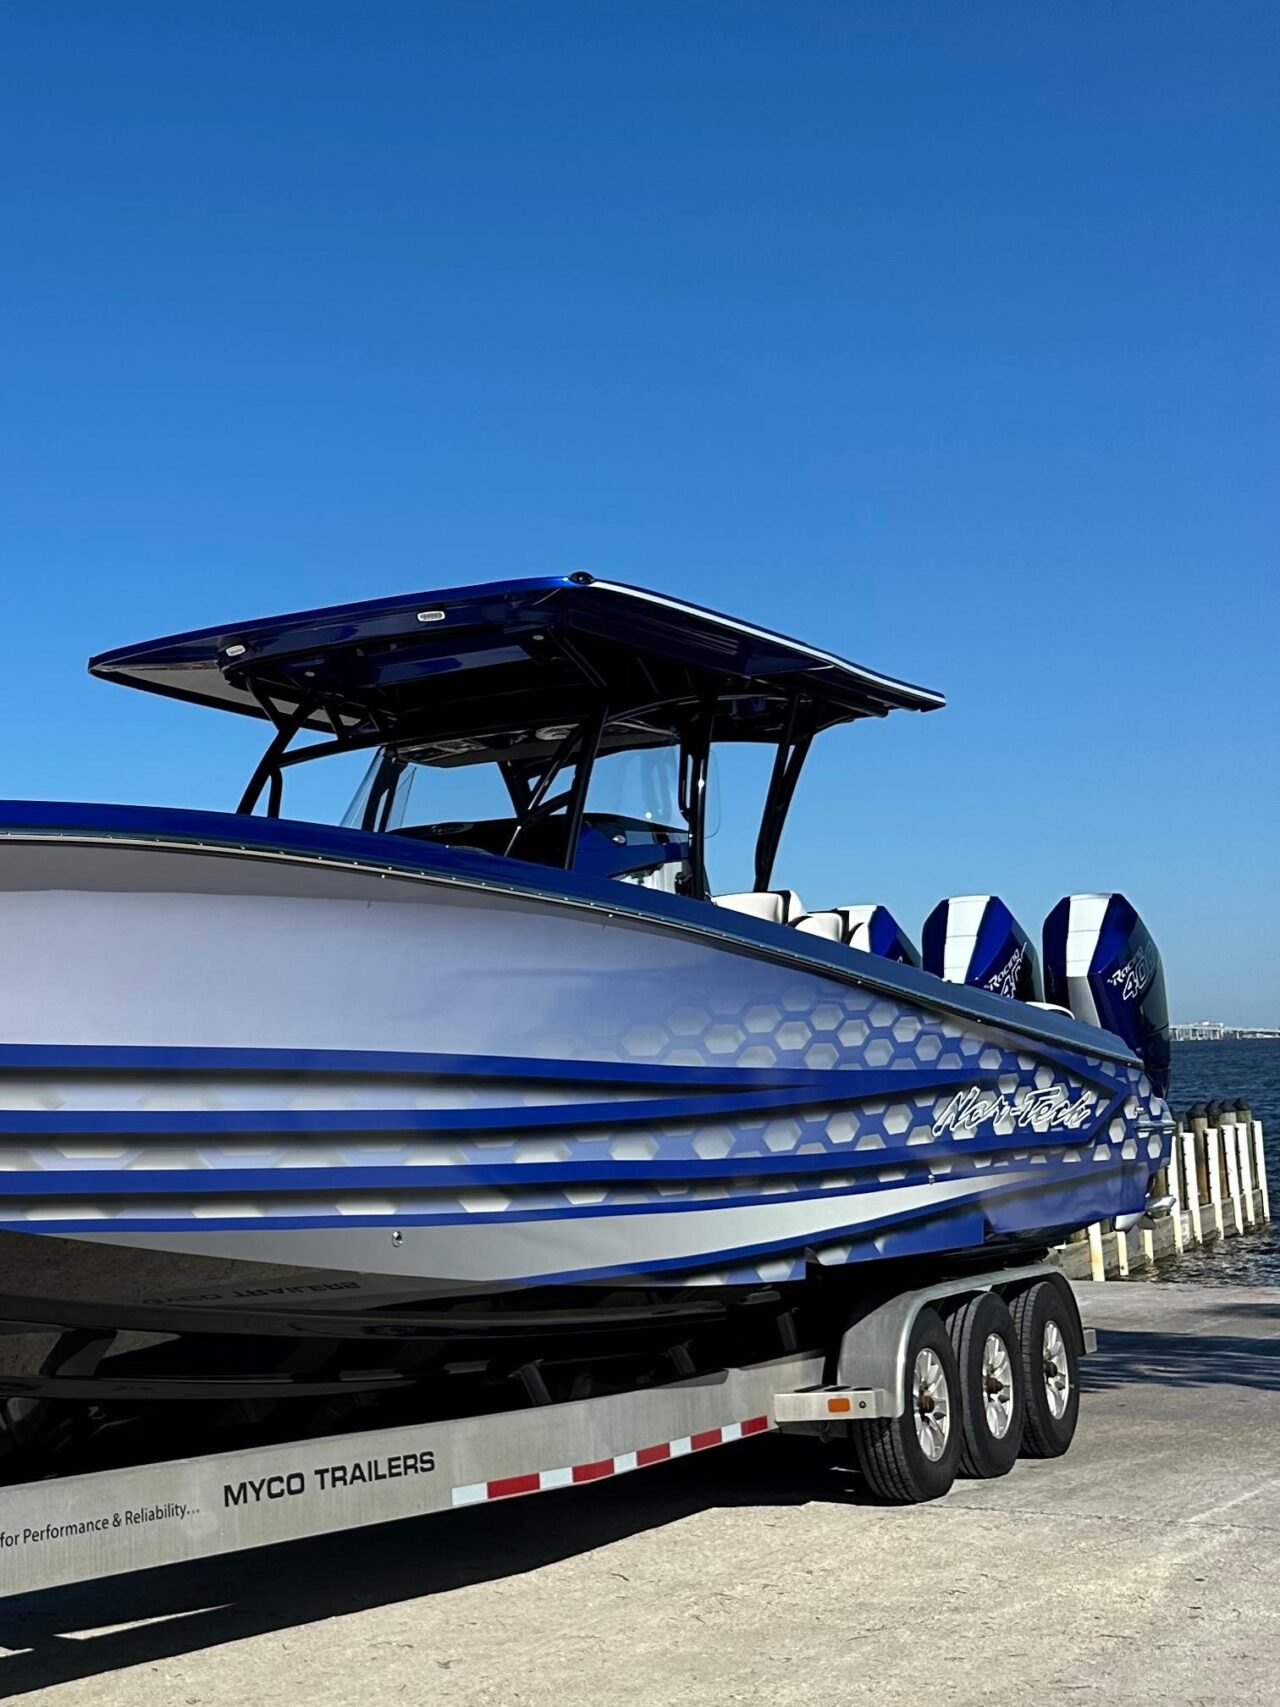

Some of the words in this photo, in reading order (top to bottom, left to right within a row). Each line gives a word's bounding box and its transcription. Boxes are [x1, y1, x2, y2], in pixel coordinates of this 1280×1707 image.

[932, 1086, 1091, 1137] Nor-Tech
[224, 1472, 305, 1508] MYCO
[314, 1450, 435, 1490] TRAILERS
[0, 1531, 20, 1548] for
[23, 1517, 109, 1544] Performance
[112, 1512, 122, 1528] &
[125, 1502, 200, 1525] Reliability...
